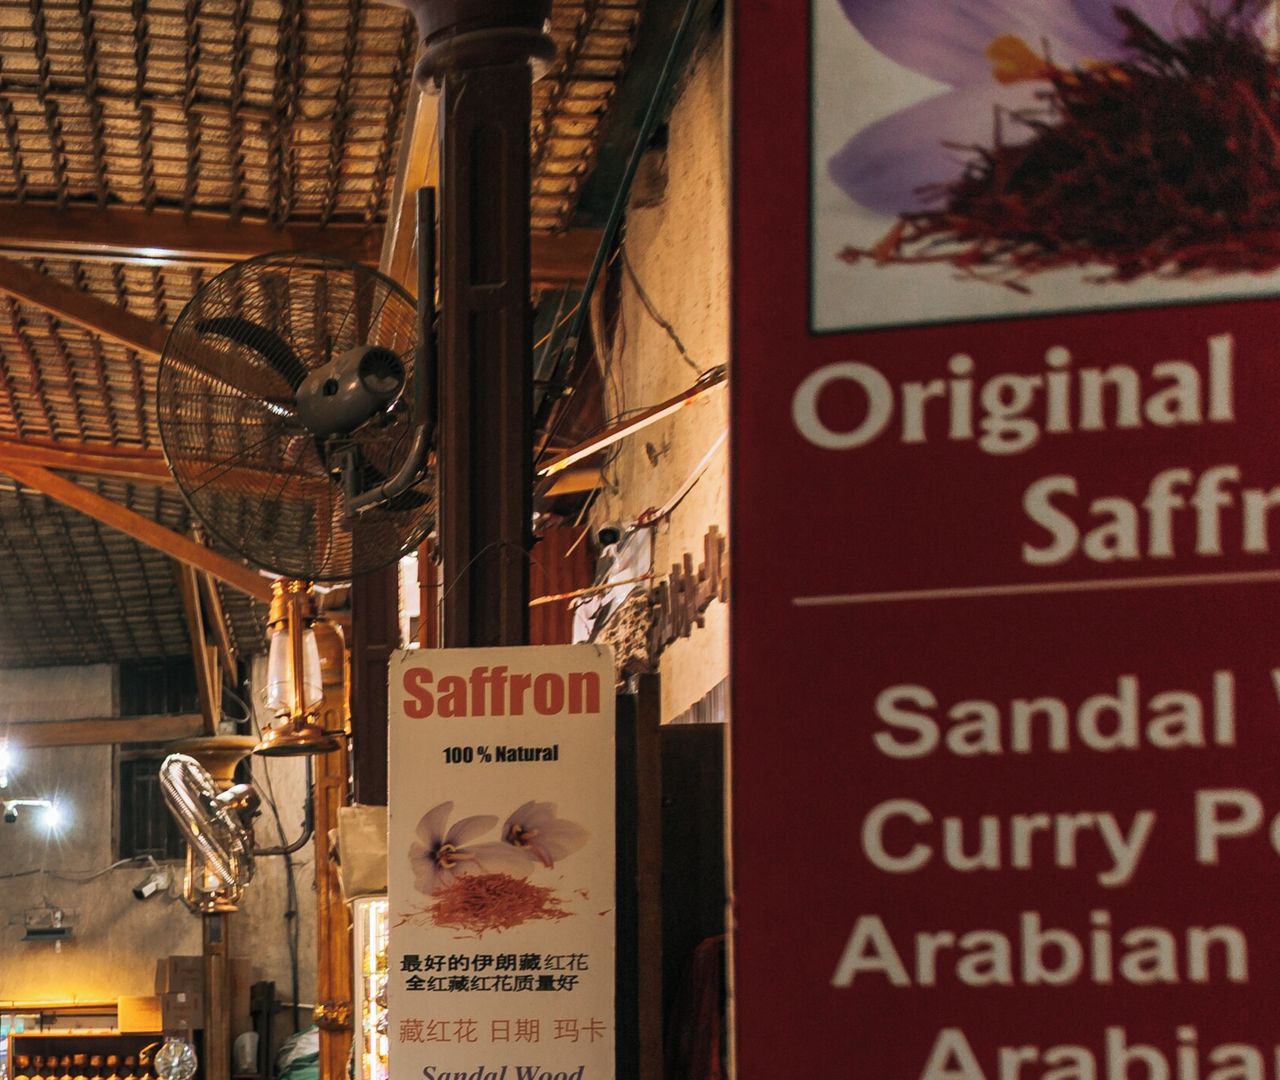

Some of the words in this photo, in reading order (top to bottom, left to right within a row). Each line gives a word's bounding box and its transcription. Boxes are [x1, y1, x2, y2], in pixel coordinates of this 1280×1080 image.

[791, 334, 1234, 456] Original
[1021, 465, 1280, 566] Saffr
[402, 664, 601, 720] Saffron
[872, 670, 1236, 759] Sandal
[442, 746, 473, 764] 100
[477, 746, 492, 764] %
[495, 744, 559, 763] Natural
[861, 799, 1156, 888] Curry
[1194, 788, 1280, 864] P
[400, 953, 589, 972] 最好的伊朗藏红花
[831, 909, 1249, 988] Arabian
[405, 975, 579, 992] 全红藏红花质量好
[399, 1018, 478, 1043] 藏红花
[491, 1018, 539, 1043] 日期
[554, 1017, 606, 1043] 玛卡
